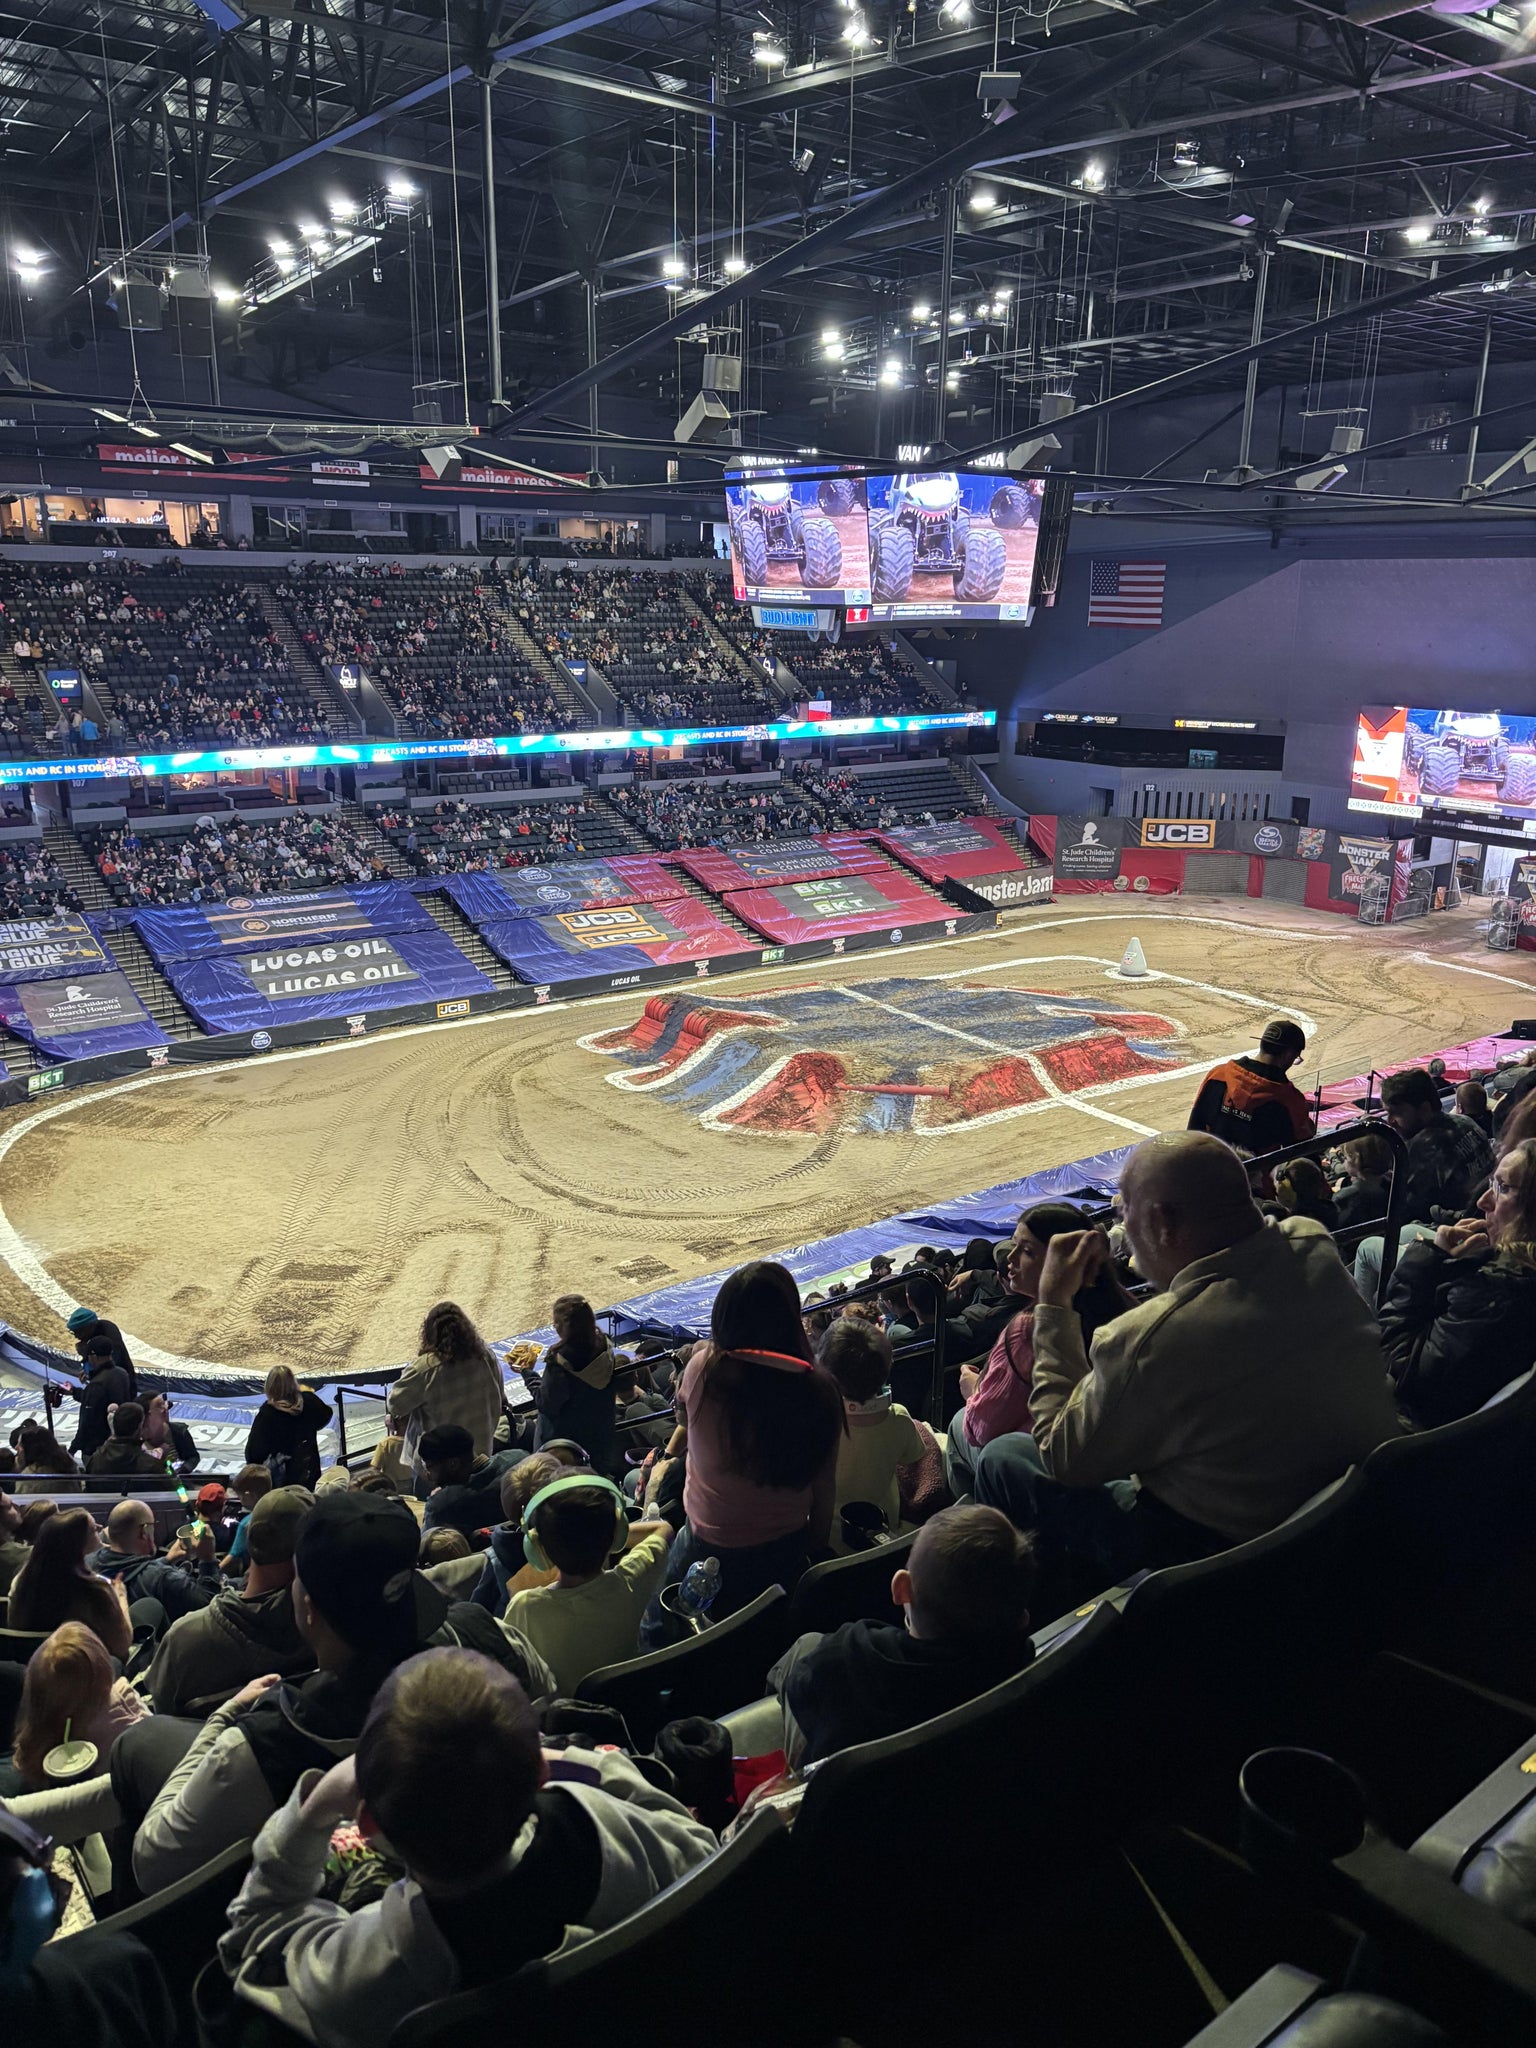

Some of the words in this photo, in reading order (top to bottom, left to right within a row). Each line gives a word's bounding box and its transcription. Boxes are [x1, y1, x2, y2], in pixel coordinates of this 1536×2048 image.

[898, 445, 921, 462] VAN
[762, 608, 782, 623] BUD
[782, 611, 816, 626] LIGHT
[1175, 719, 1185, 727] M
[410, 746, 425, 754] AND
[428, 745, 438, 753] RC
[26, 765, 47, 775] AND
[50, 765, 63, 775] RC
[64, 764, 75, 774] IN
[72, 779, 86, 787] 107
[1148, 824, 1209, 842] JCB
[760, 844, 818, 855] COMMISSION
[780, 840, 814, 848] SPORTS
[1338, 844, 1391, 861] MONSTER
[799, 855, 835, 864] SPORTS
[1089, 856, 1115, 864] Hospital
[1350, 856, 1376, 867] JAM
[780, 860, 840, 872] COMMISSION
[795, 880, 842, 895] BKT
[255, 893, 320, 904] NORTHERN
[817, 898, 863, 914] BKT
[271, 914, 337, 925] NORTHERN
[569, 912, 637, 928] JCB
[0, 930, 50, 944] GLUE
[8, 953, 65, 969] GLUE
[251, 948, 338, 973] LUCAS
[762, 950, 784, 962] BKT
[268, 971, 356, 995] LUCAS
[611, 977, 629, 987] LUCAS
[629, 975, 641, 985] OIL
[48, 1008, 86, 1019] Research
[86, 1003, 122, 1015] Hospital
[58, 1003, 77, 1013] Jude
[440, 1003, 468, 1015] JCB
[28, 1070, 64, 1090] BKT
